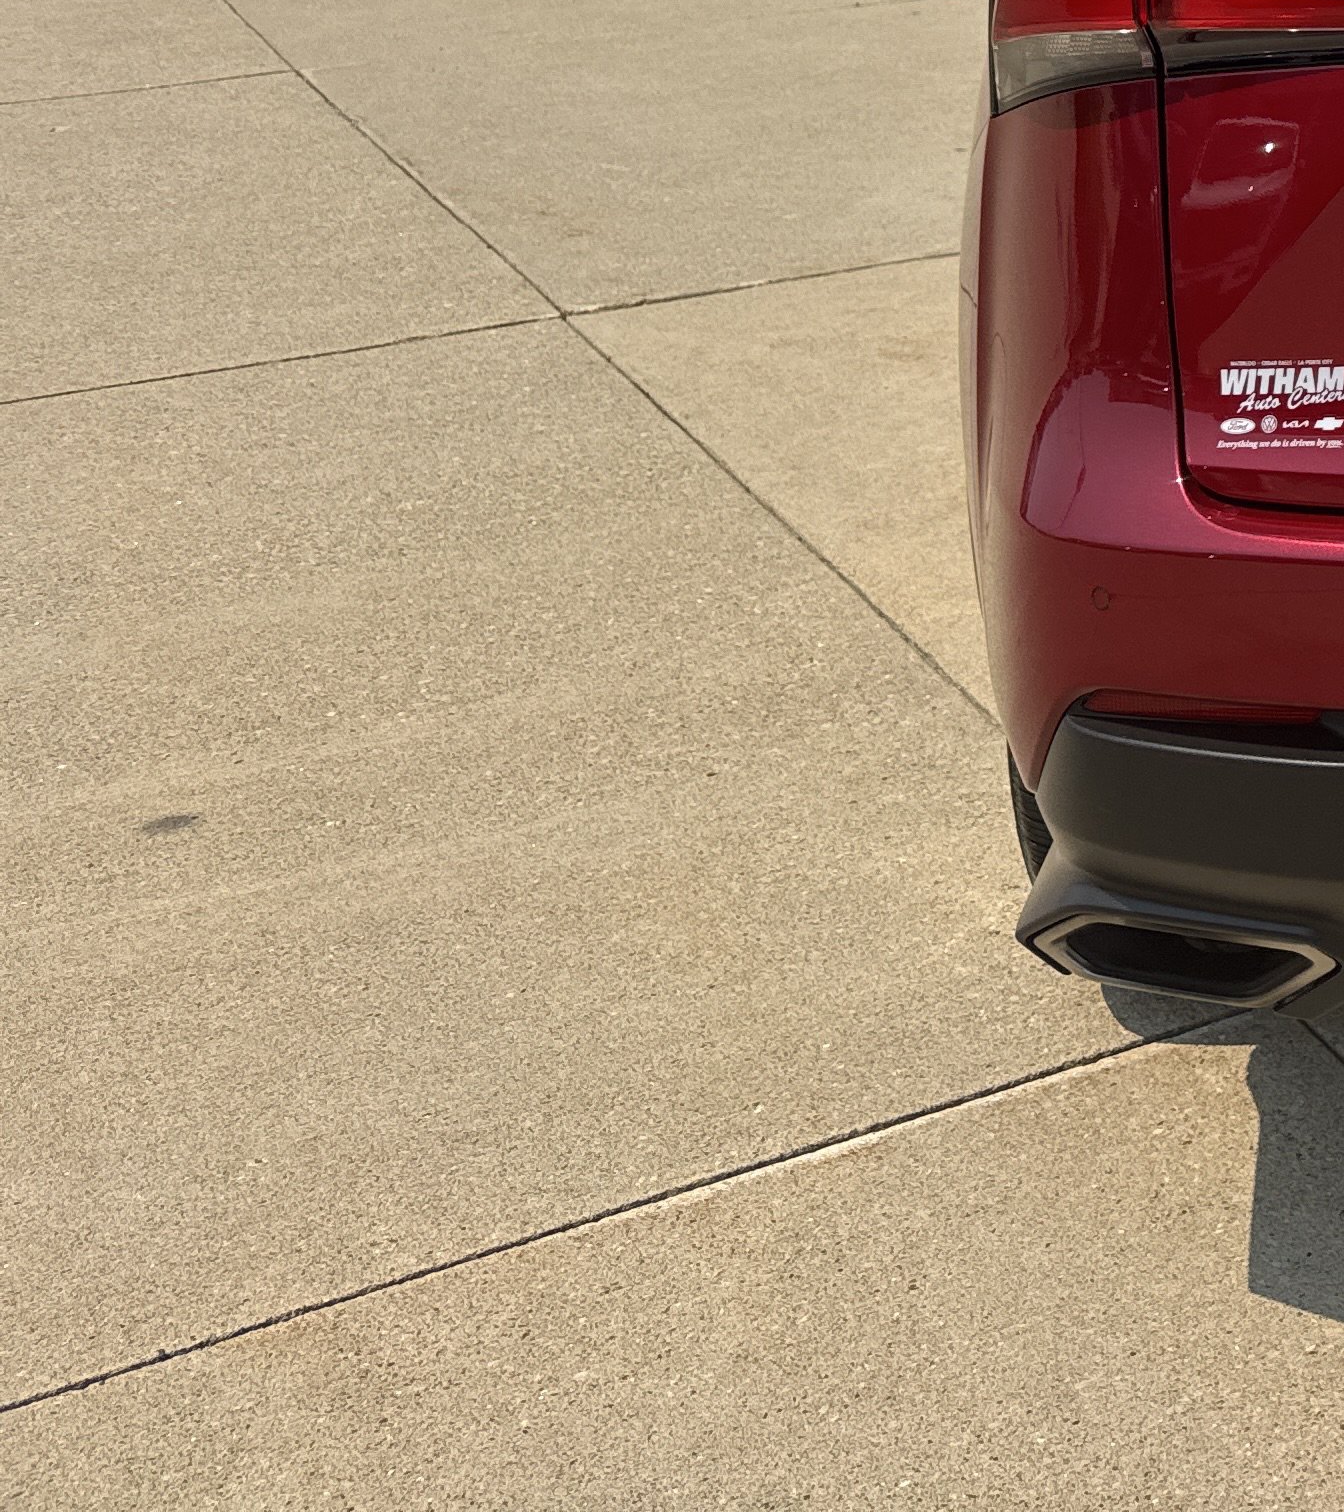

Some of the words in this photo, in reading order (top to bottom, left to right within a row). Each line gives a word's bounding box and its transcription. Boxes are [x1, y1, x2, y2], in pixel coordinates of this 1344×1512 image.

[1220, 366, 1344, 395] WITHAM
[1236, 393, 1281, 413] Auto
[1217, 439, 1257, 449] Everything
[1271, 439, 1281, 447] do
[1317, 438, 1327, 448] by
